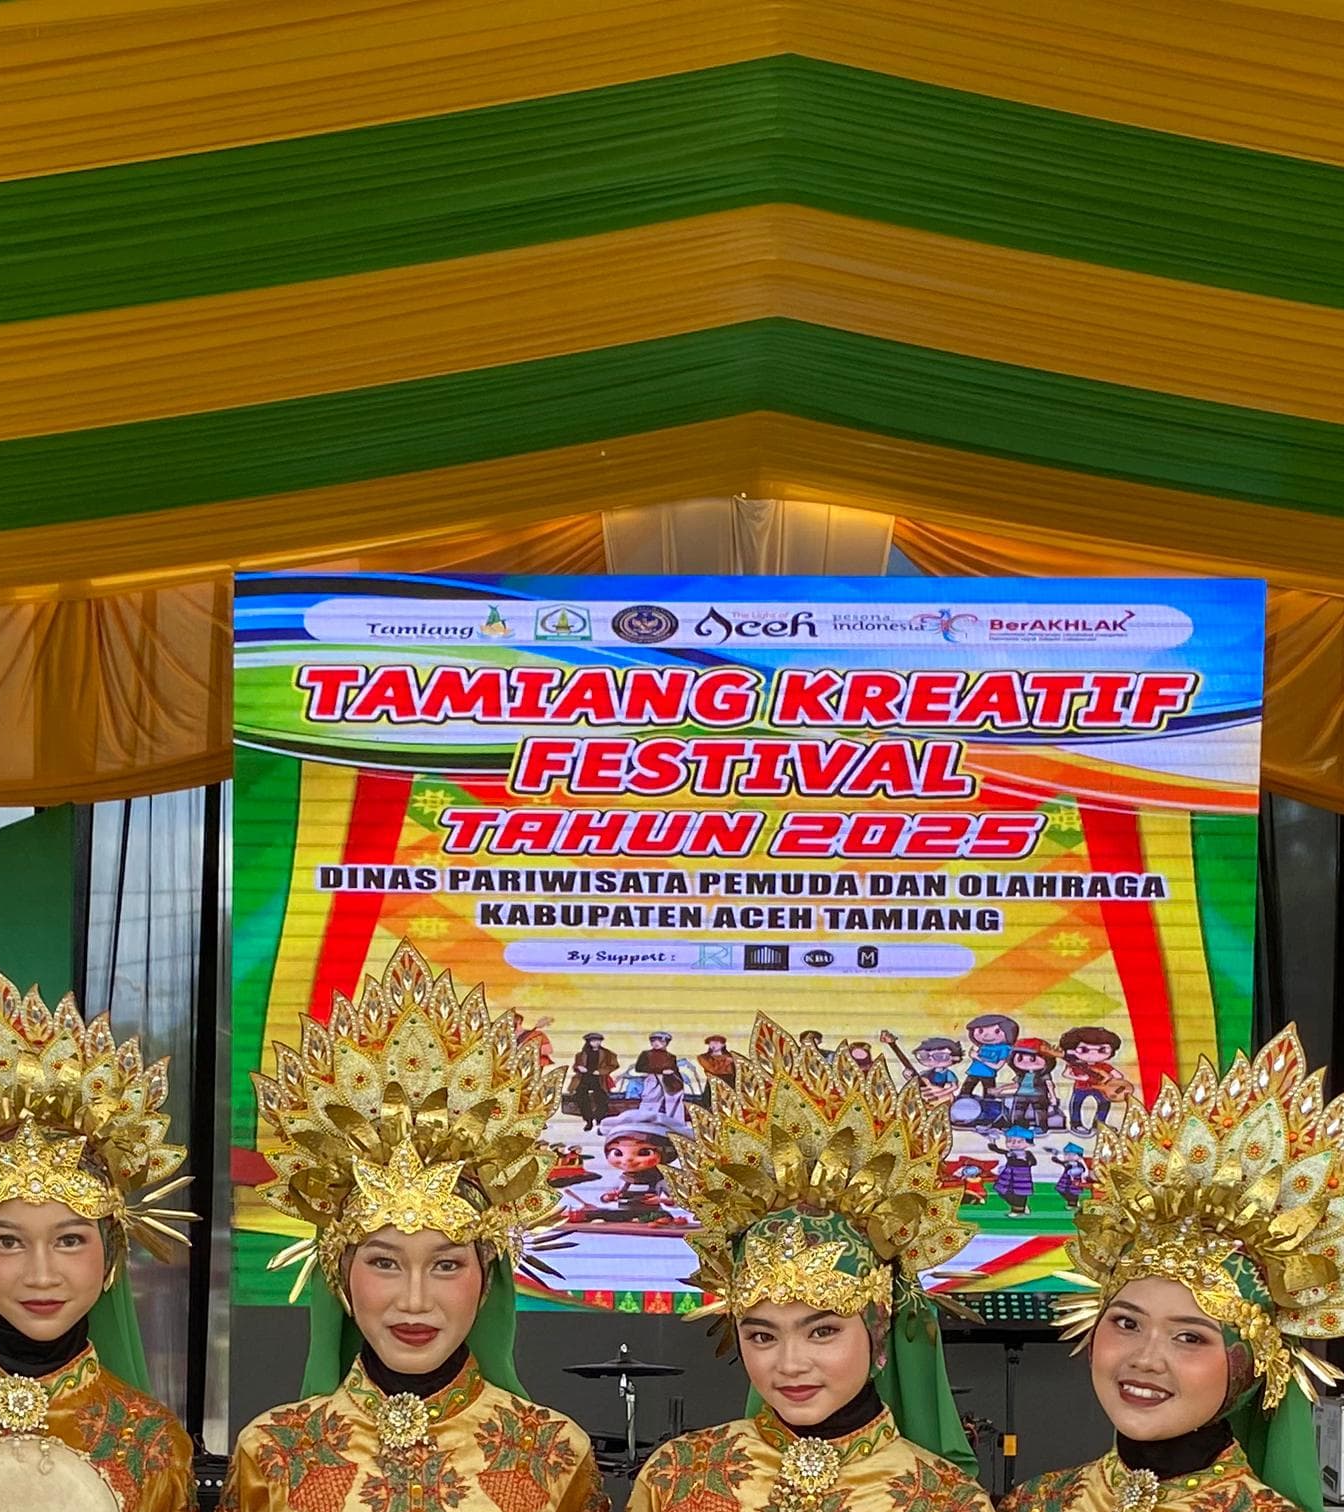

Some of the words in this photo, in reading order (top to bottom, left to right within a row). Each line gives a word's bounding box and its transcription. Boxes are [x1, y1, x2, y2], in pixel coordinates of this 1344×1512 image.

[365, 621, 474, 639] Tamiang
[694, 606, 818, 645] Aceh
[989, 617, 1130, 632] BerAKHLAK
[303, 666, 760, 725] TAMIANG
[770, 669, 1197, 729] KREATIF
[512, 737, 975, 796] FESTIVAL
[441, 808, 764, 857] TAHUN
[768, 812, 1047, 859] 2025
[319, 866, 438, 891] DINAS
[448, 868, 688, 894] PARIWISATA
[698, 871, 860, 897] PEMUDA
[869, 873, 947, 898] DAN
[958, 874, 1166, 899] OLAHRAGA
[480, 903, 702, 929] KABUPATEN
[712, 906, 813, 931] ACEH
[823, 907, 1002, 932] TAMIANG
[567, 950, 591, 963] By
[595, 950, 667, 965] Support
